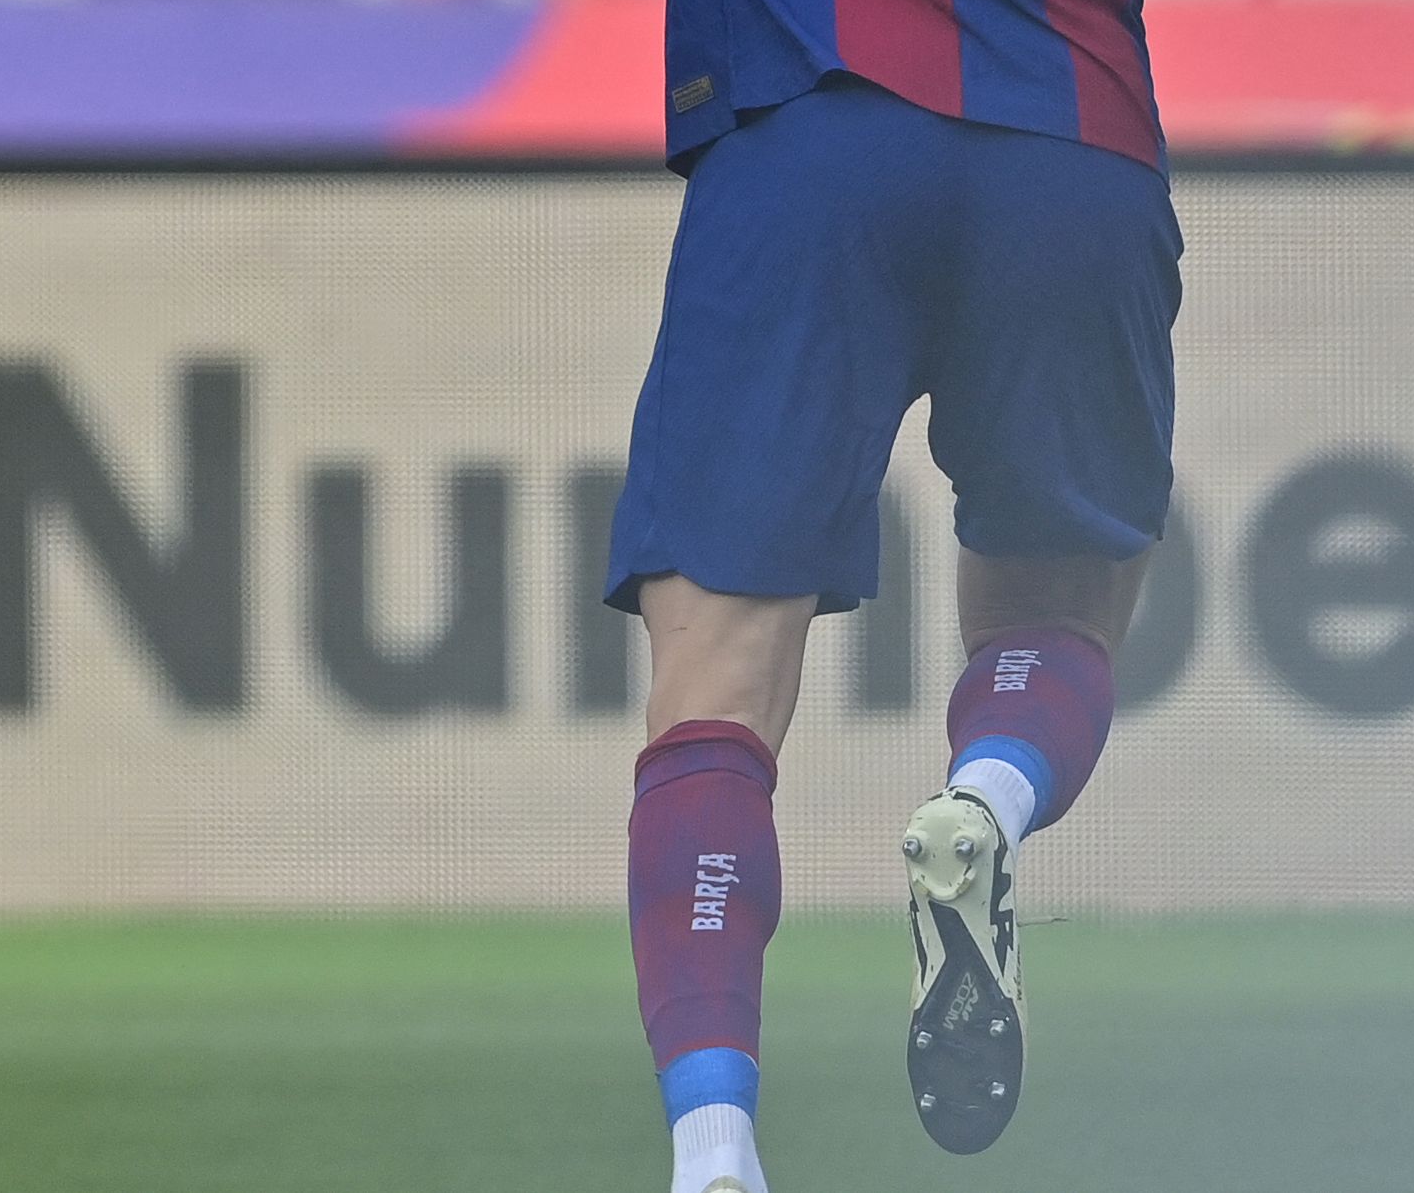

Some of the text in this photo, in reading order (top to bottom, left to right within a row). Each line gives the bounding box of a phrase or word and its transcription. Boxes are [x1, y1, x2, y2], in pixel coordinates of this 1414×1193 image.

[993, 649, 1042, 693] BARÇA
[691, 854, 740, 931] BARÇA
[943, 972, 974, 1030] ZOOM
